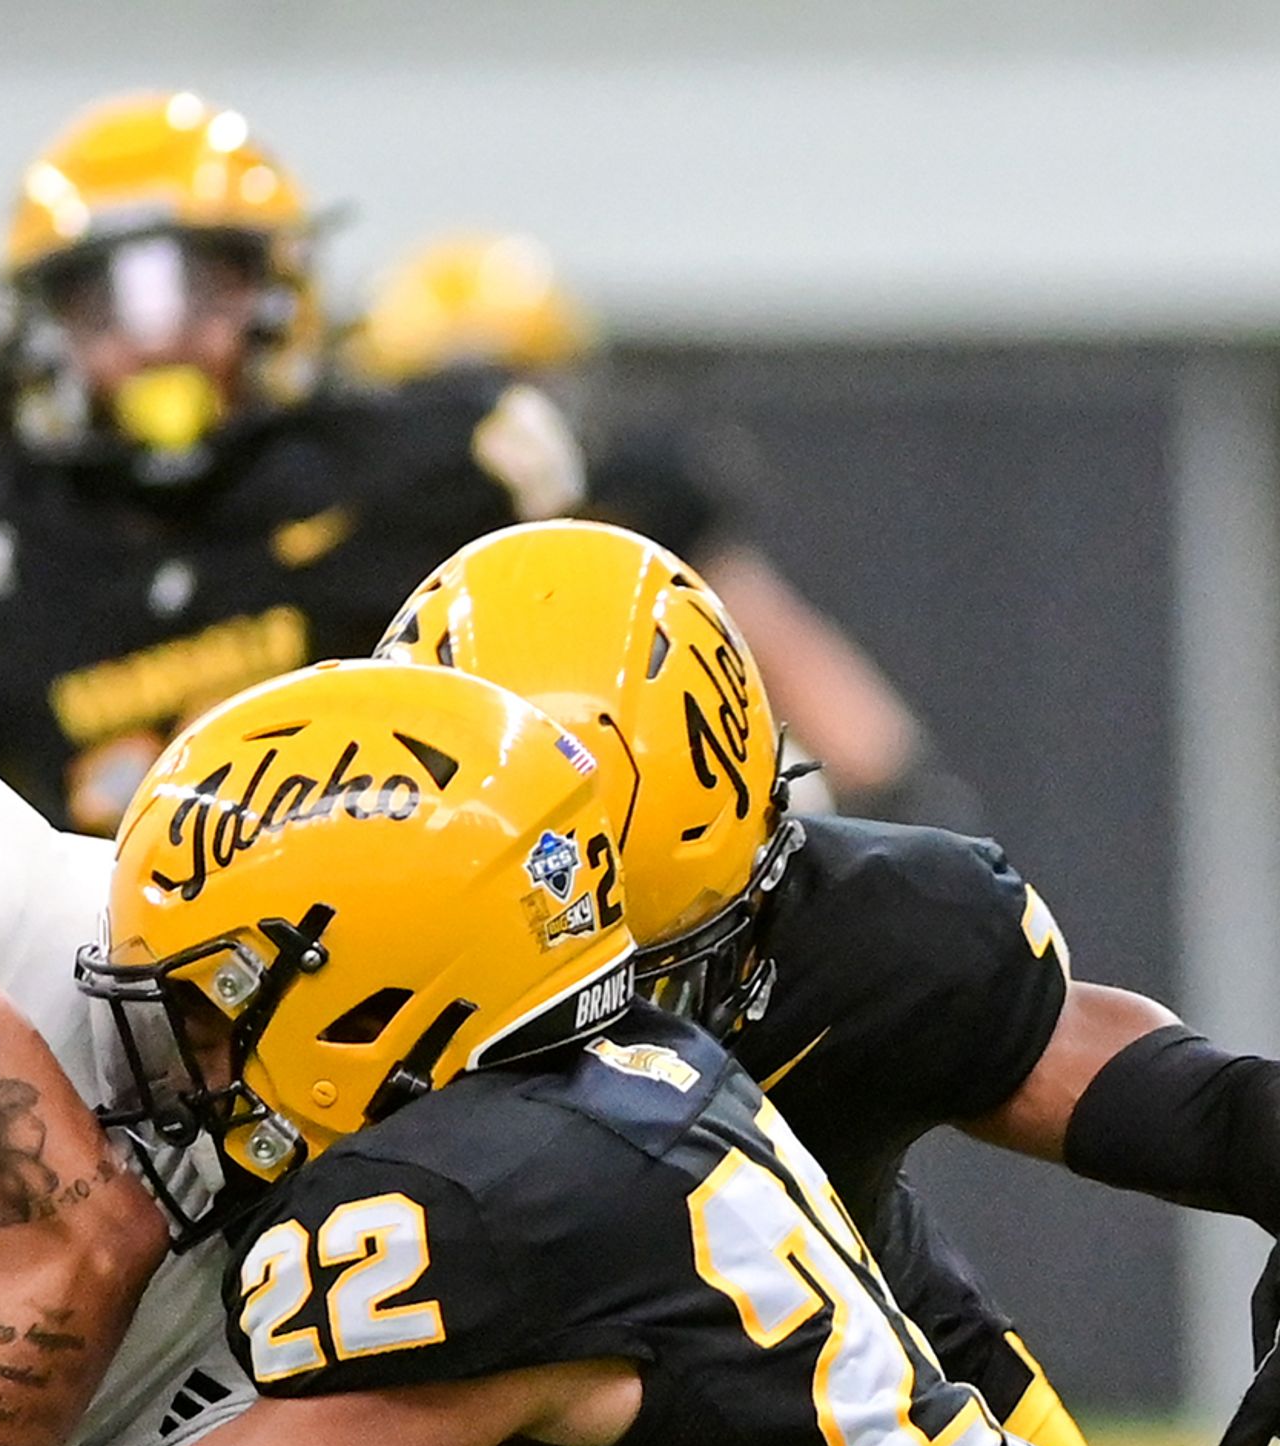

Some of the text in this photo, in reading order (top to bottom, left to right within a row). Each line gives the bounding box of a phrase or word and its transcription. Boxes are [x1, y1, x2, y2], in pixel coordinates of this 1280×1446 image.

[169, 740, 420, 902] Idaho
[533, 850, 574, 876] FCS
[575, 968, 627, 1030] BRAVE
[239, 1189, 447, 1383] 22
